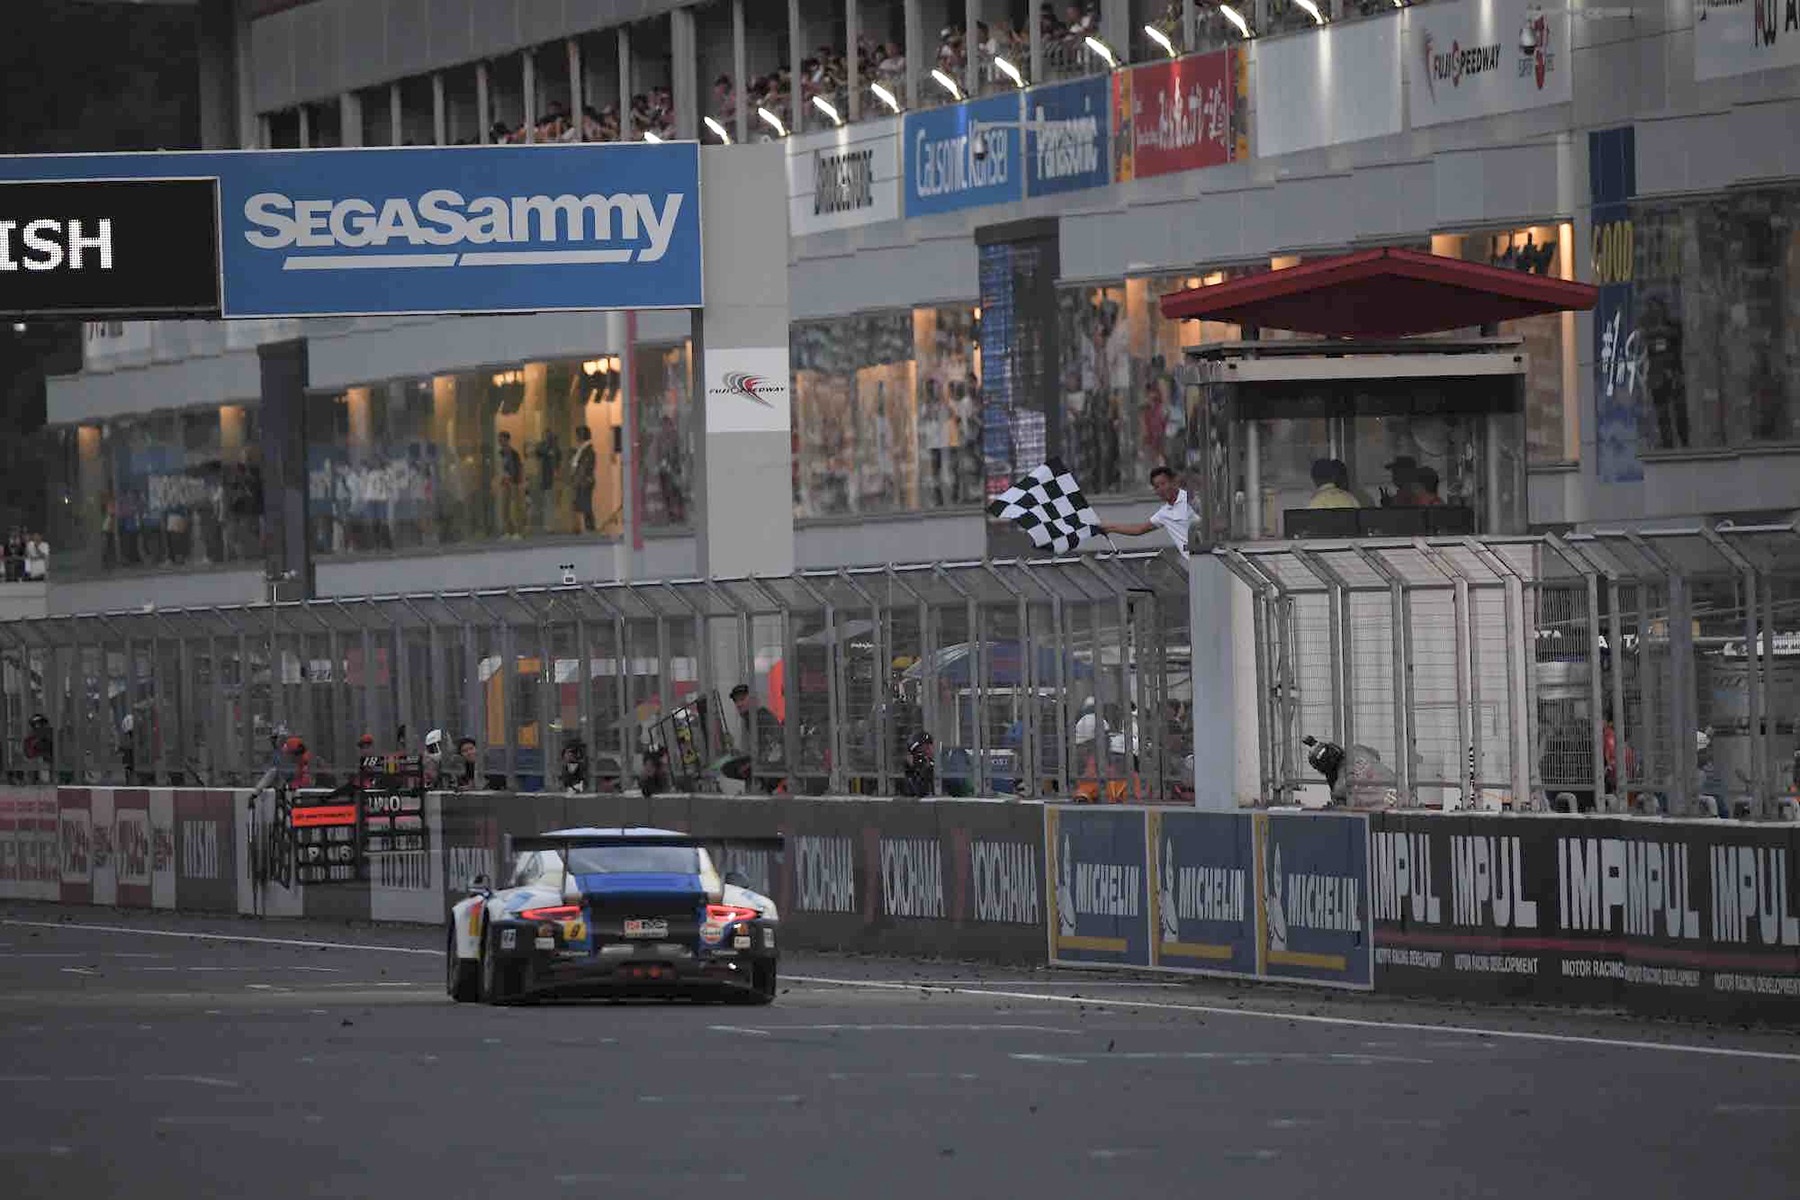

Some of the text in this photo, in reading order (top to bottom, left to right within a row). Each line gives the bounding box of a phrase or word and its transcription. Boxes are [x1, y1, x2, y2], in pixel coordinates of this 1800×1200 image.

[243, 189, 684, 263] SEGASammy
[1076, 863, 1140, 916] MICHELIN
[1178, 866, 1246, 922] MICHELIN
[1562, 959, 1625, 979] MOTOR RACING
